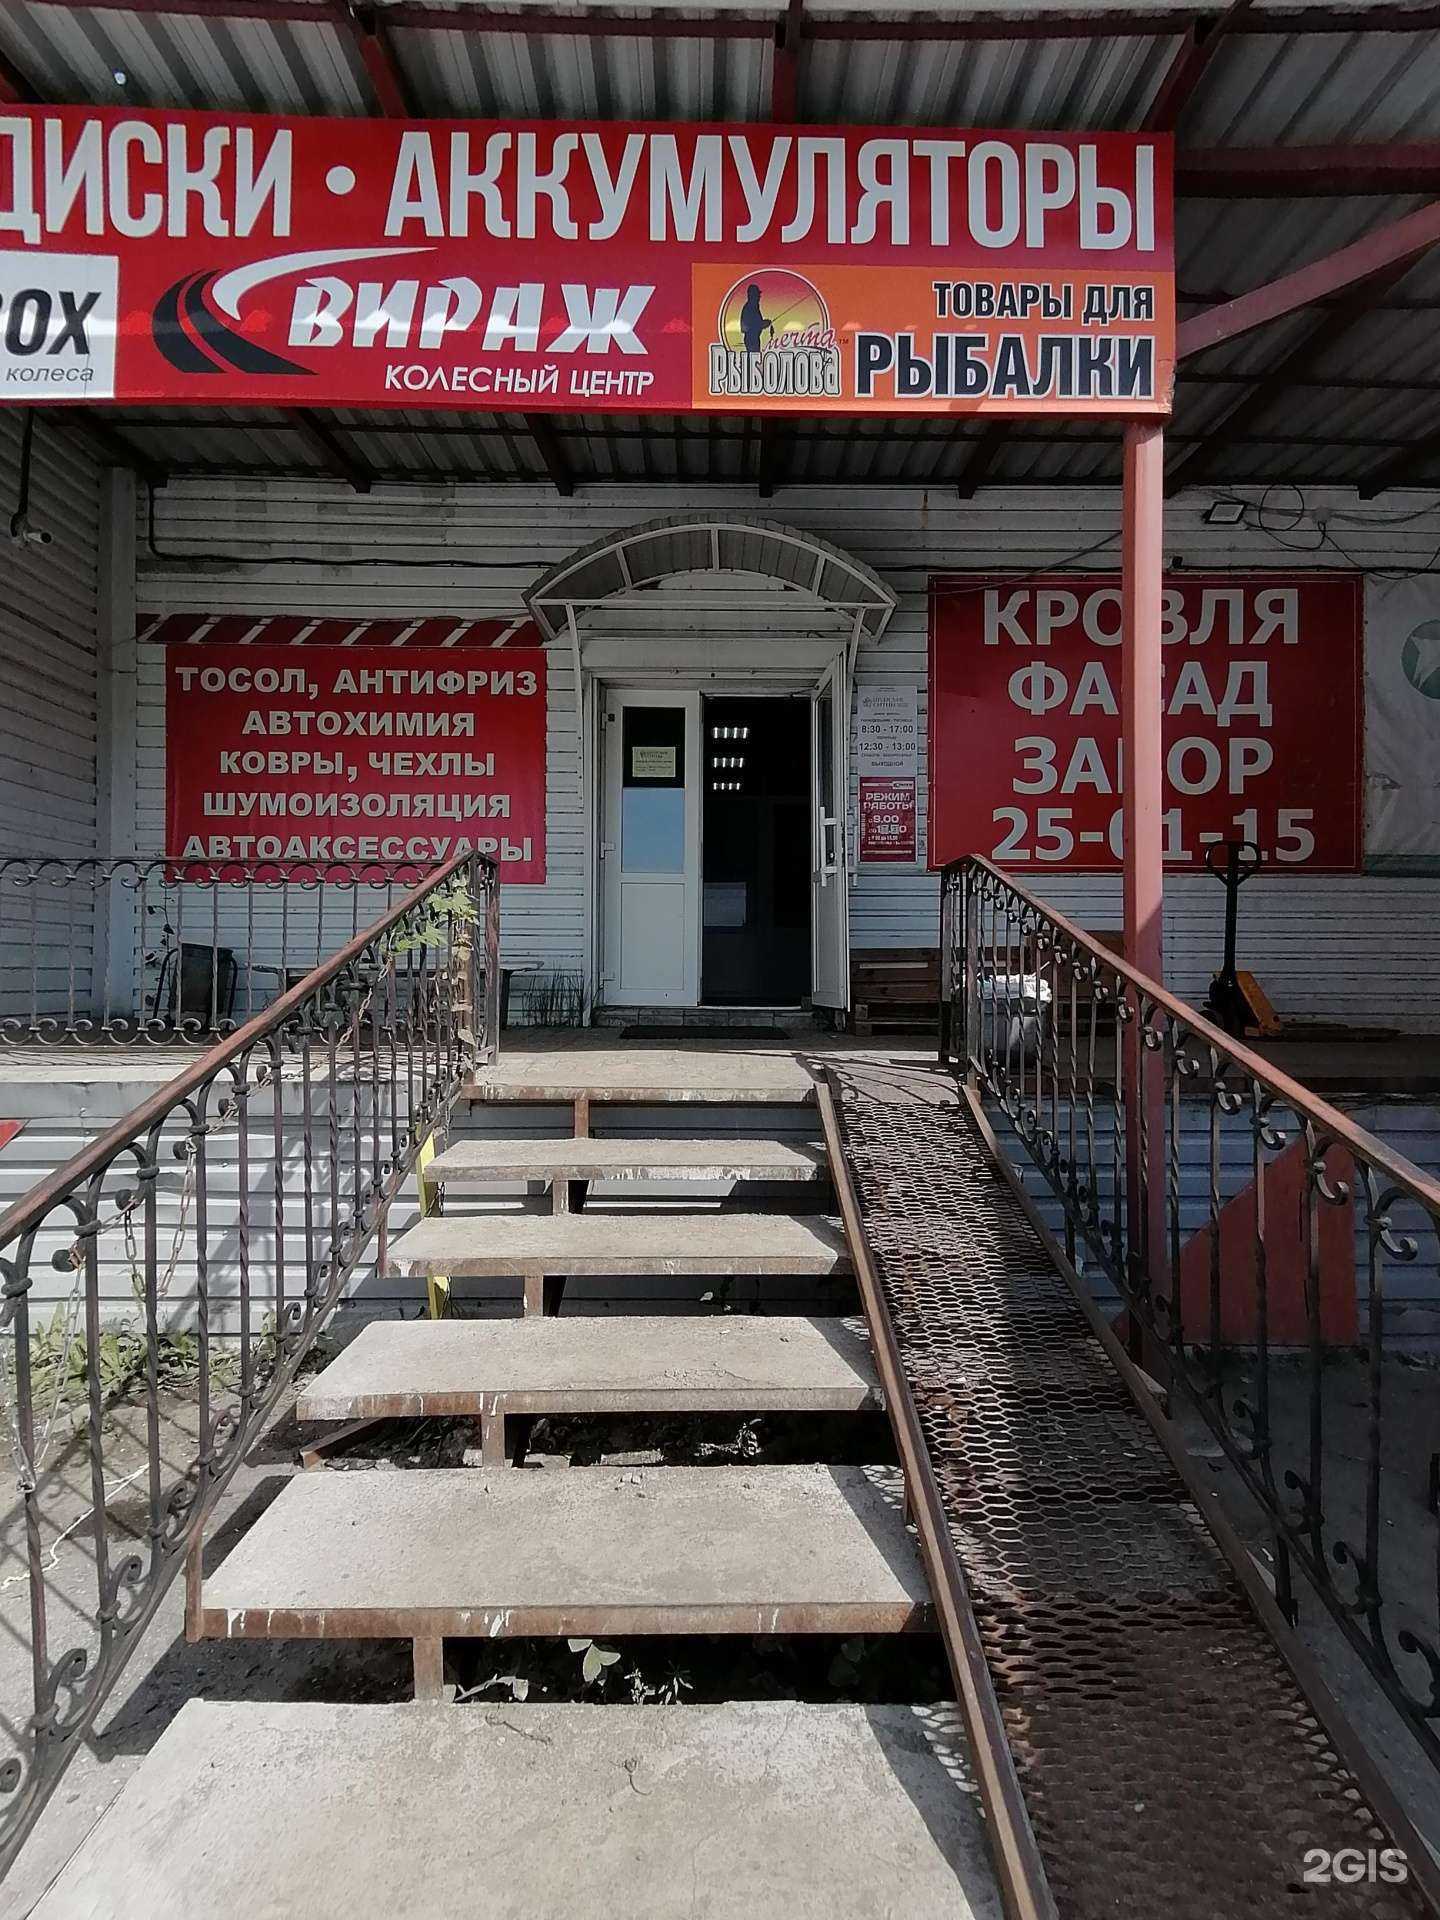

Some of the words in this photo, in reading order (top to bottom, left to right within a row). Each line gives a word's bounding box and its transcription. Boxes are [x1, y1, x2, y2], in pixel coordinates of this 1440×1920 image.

[383, 130, 1155, 252] АККУМУЛЯТОРЫ
[287, 276, 656, 355] ВИРАЖ
[932, 281, 1072, 320] ТОВАРЫ
[1082, 284, 1155, 325] ДЛЯ
[6, 367, 95, 382] колеса
[384, 363, 560, 394] КОЛЕСНЫЙ
[569, 369, 655, 398] ЦЕНТР
[855, 332, 1156, 400] РЫБАЛКИ
[175, 666, 319, 699] ТОСОЛ,
[332, 668, 538, 697] АНТИФРИЗ
[1007, 660, 1274, 728] ФААД
[240, 710, 476, 738] АВТОХИМИЯ
[861, 725, 881, 734] 8:30
[889, 725, 914, 734] 17:00
[859, 742, 883, 751] 12:30
[892, 742, 916, 751] 13:00
[219, 750, 359, 783] КОВРЫ,
[369, 752, 496, 777] ЧЕХЛЫ
[1011, 735, 1274, 796] ЗАОР
[202, 791, 512, 822] ШУМОИЗОЛЯЦИЯ
[863, 801, 915, 810] РАБОТЫ
[865, 792, 911, 801] РЕЖИМ
